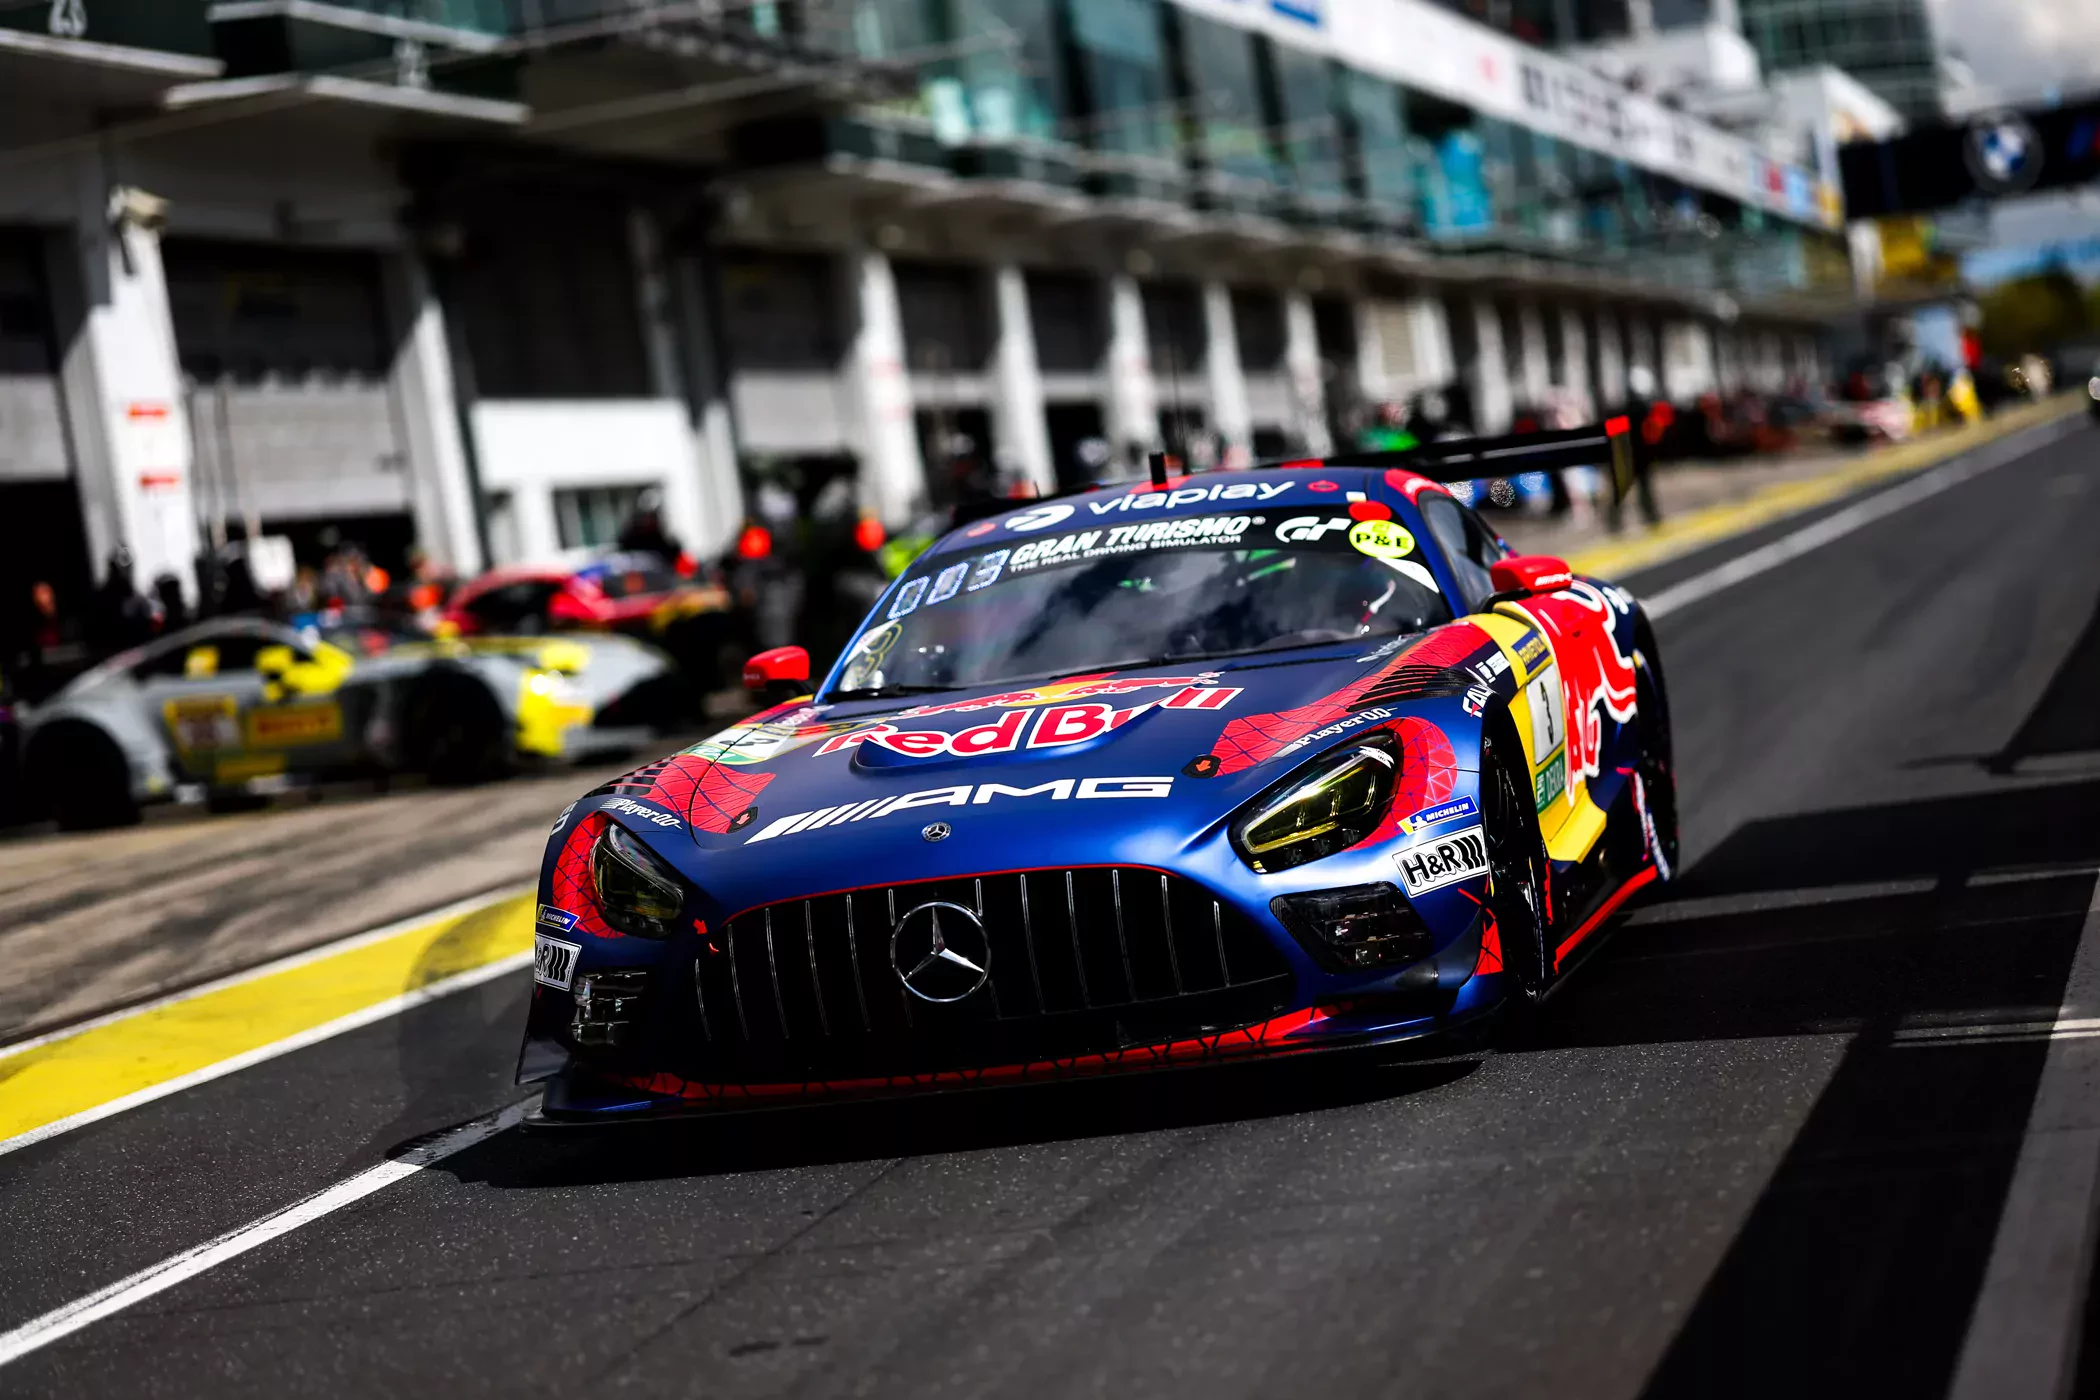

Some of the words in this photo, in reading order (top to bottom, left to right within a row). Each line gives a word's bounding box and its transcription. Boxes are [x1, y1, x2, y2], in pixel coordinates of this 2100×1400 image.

[1088, 481, 1295, 514] viaplay
[1008, 559, 1037, 573] THE
[1041, 552, 1080, 568] REAL
[1084, 540, 1148, 559] DRIVING
[1150, 534, 1242, 550] SIMULATOR
[1009, 530, 1102, 565] GRAN
[812, 708, 1035, 758] Red
[1426, 803, 1469, 821] MICHELIN
[1401, 843, 1462, 884] H&R
